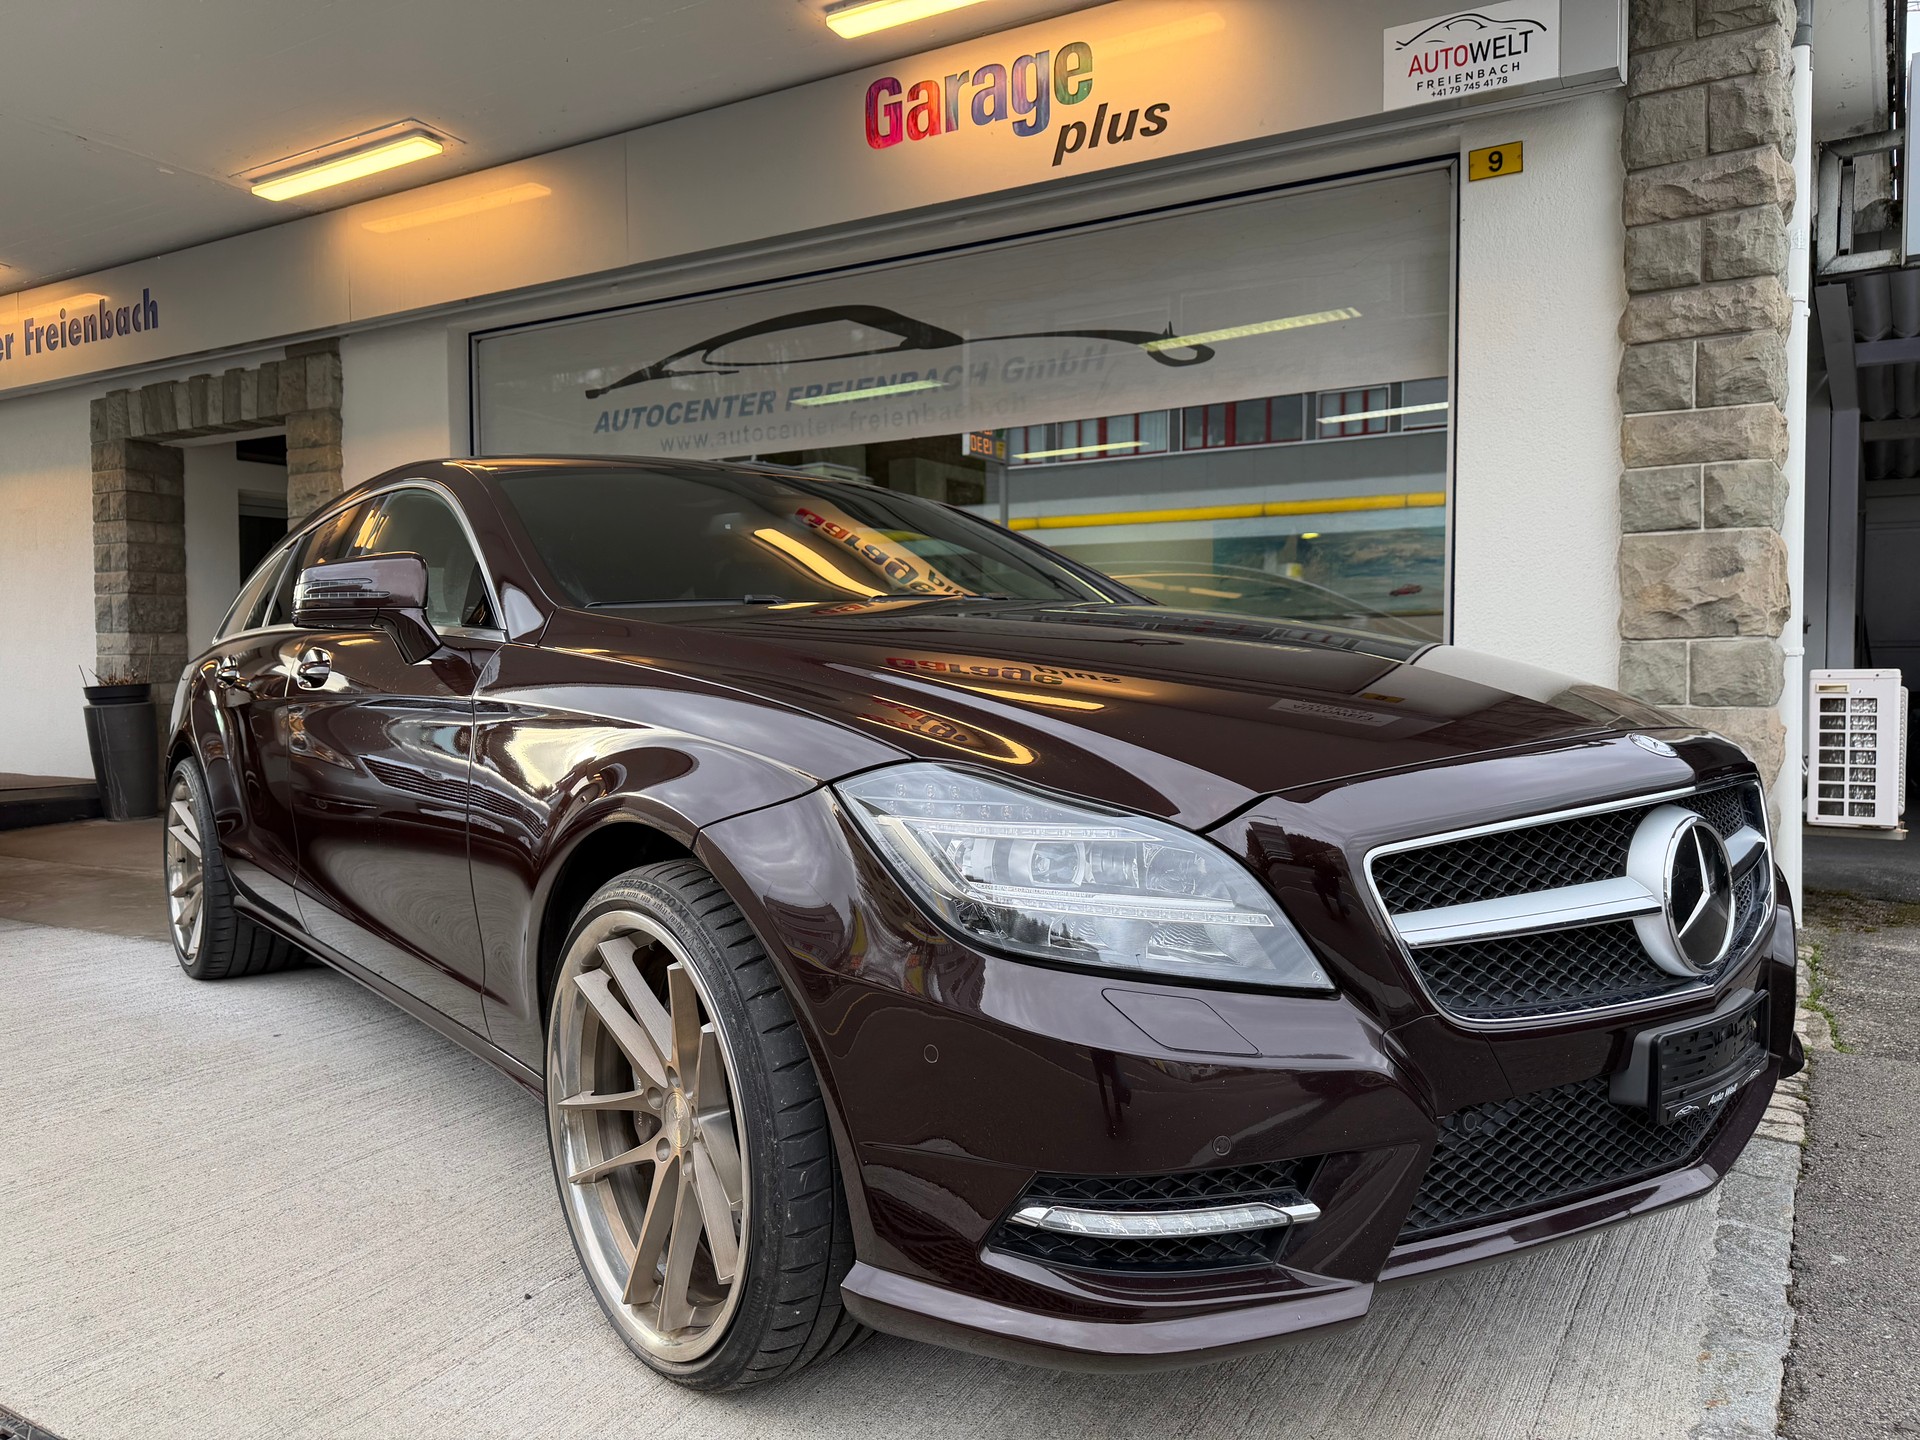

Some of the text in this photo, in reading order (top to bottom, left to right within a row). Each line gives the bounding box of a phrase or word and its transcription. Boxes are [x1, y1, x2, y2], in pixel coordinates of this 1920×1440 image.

[1408, 29, 1534, 78] AUTOWELT
[1417, 61, 1520, 91] FREIENBACH
[865, 41, 1094, 150] Garage
[1431, 75, 1508, 98] +41 79 745 41 78
[1052, 102, 1171, 167] plus
[1488, 150, 1503, 173] 9
[0, 288, 159, 361] r Freienbach
[593, 390, 777, 434] AUTOCENTER
[1001, 344, 1109, 384] GmbH
